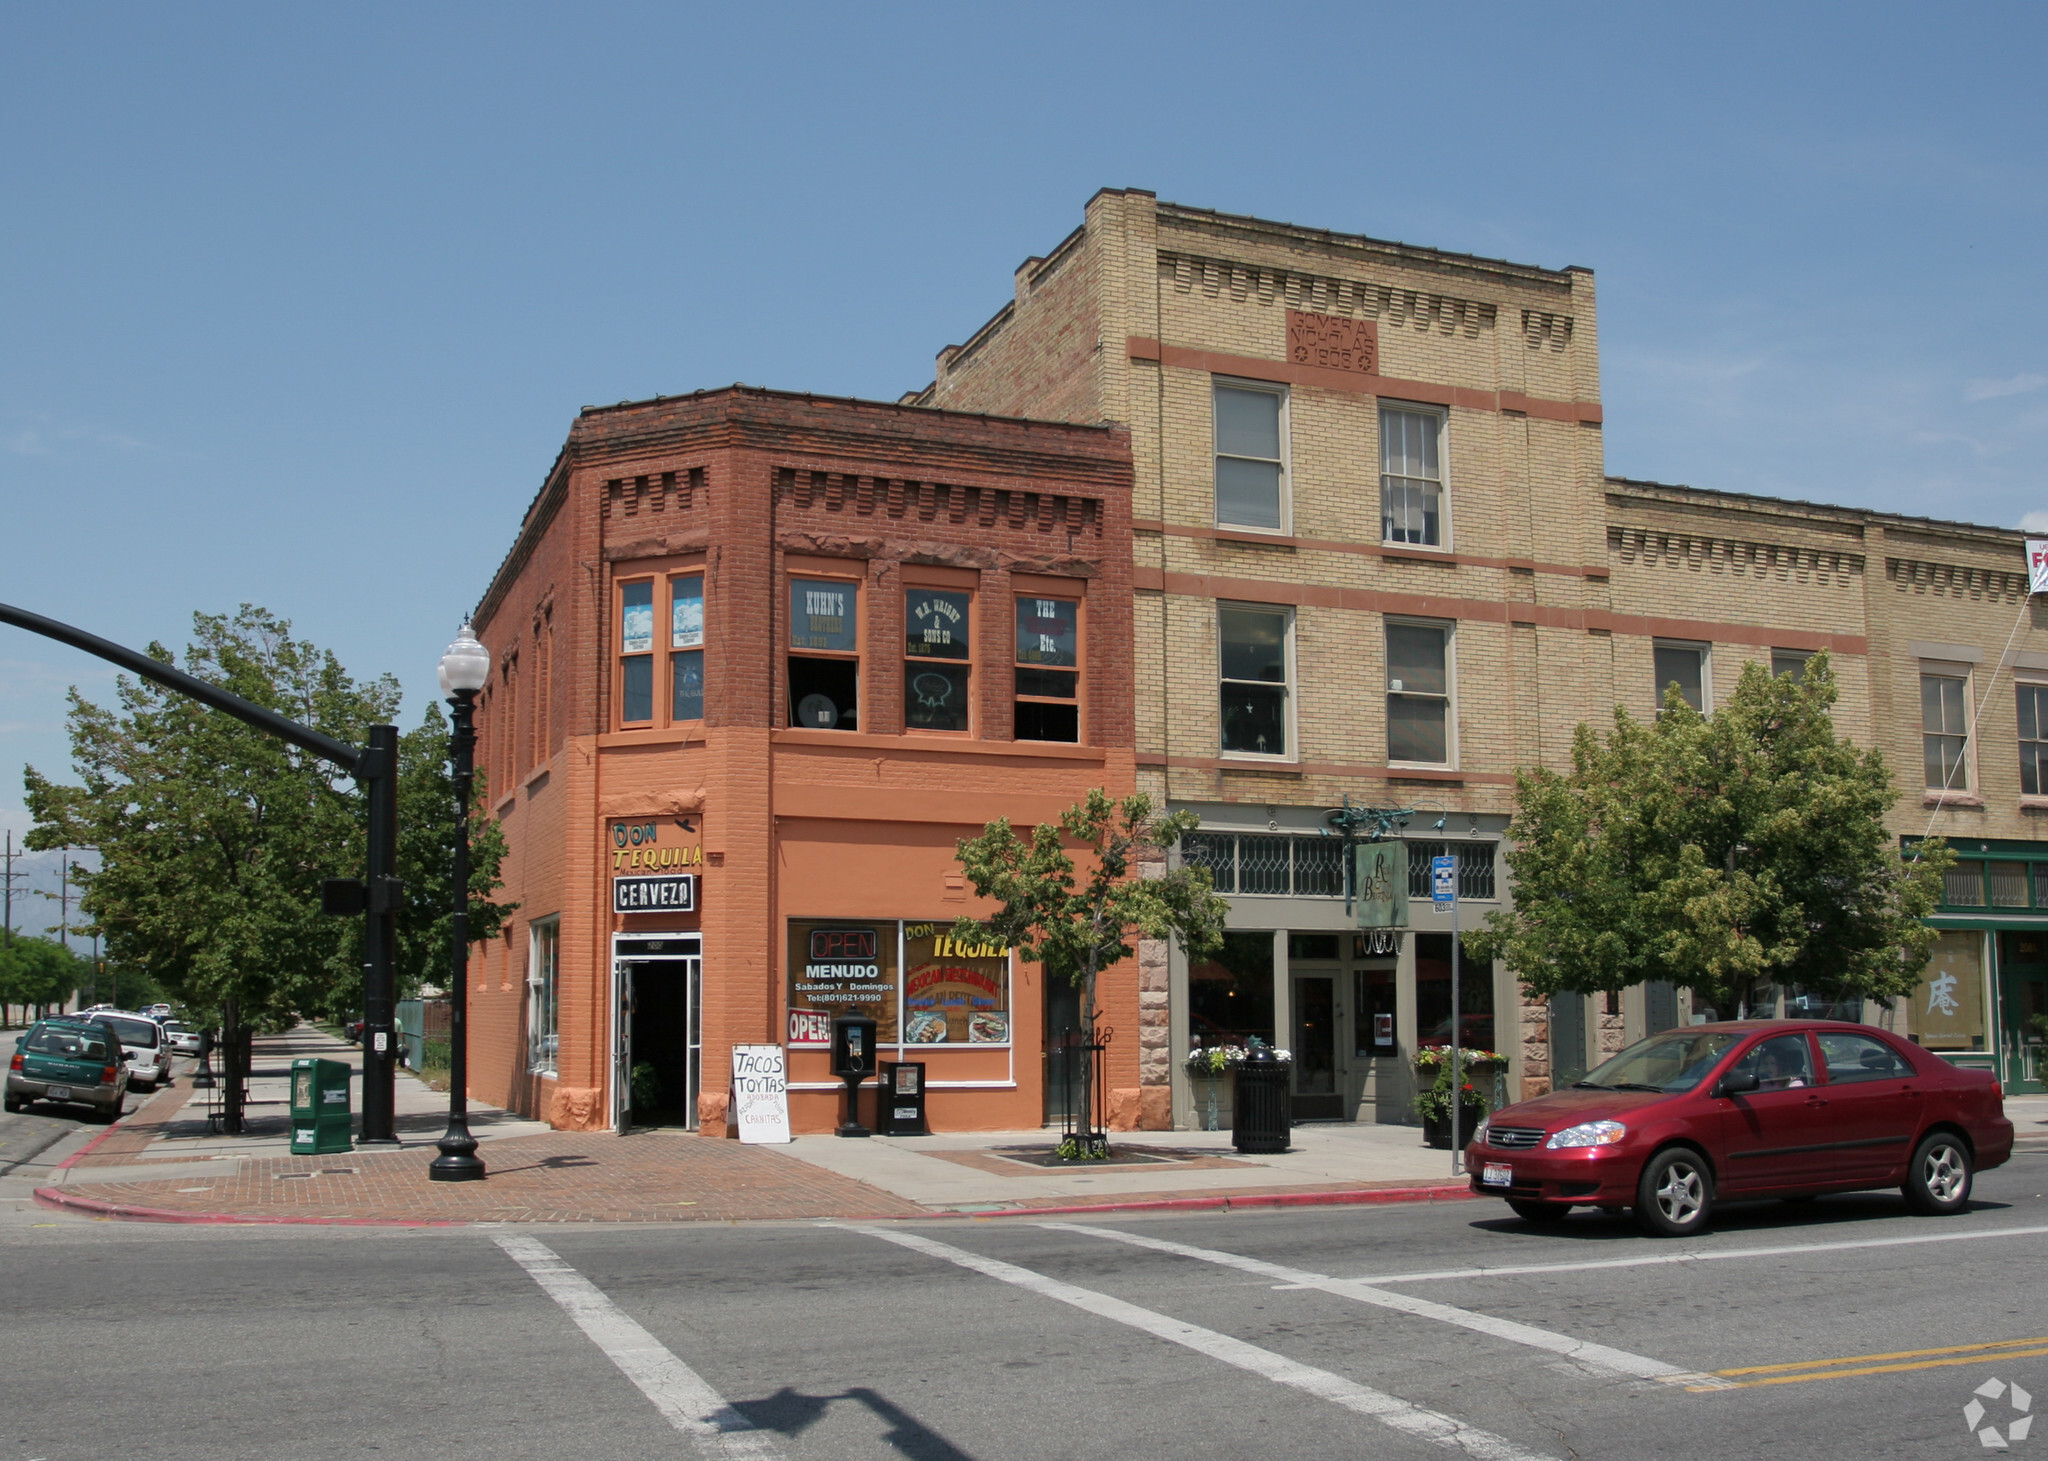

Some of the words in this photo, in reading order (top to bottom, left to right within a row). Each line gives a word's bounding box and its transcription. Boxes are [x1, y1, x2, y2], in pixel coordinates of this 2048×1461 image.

[1291, 327, 1374, 355] NICHOLAS
[806, 591, 844, 617] KUHN'S
[933, 599, 960, 623] WRIGHT
[1036, 600, 1055, 618] THE
[934, 615, 940, 628] &
[1040, 634, 1056, 652] Etc.
[613, 822, 657, 848] DON
[612, 844, 702, 872] TEQUILA
[619, 883, 688, 907] CERVEZA
[905, 923, 935, 941] DON
[814, 933, 874, 957] OPEN
[806, 965, 879, 978] MENUDO
[795, 983, 835, 991] Sabados
[836, 983, 843, 991] Y
[850, 983, 894, 992] Domingos
[735, 1053, 783, 1073] TACOS
[745, 1114, 782, 1125] CARNITAS
